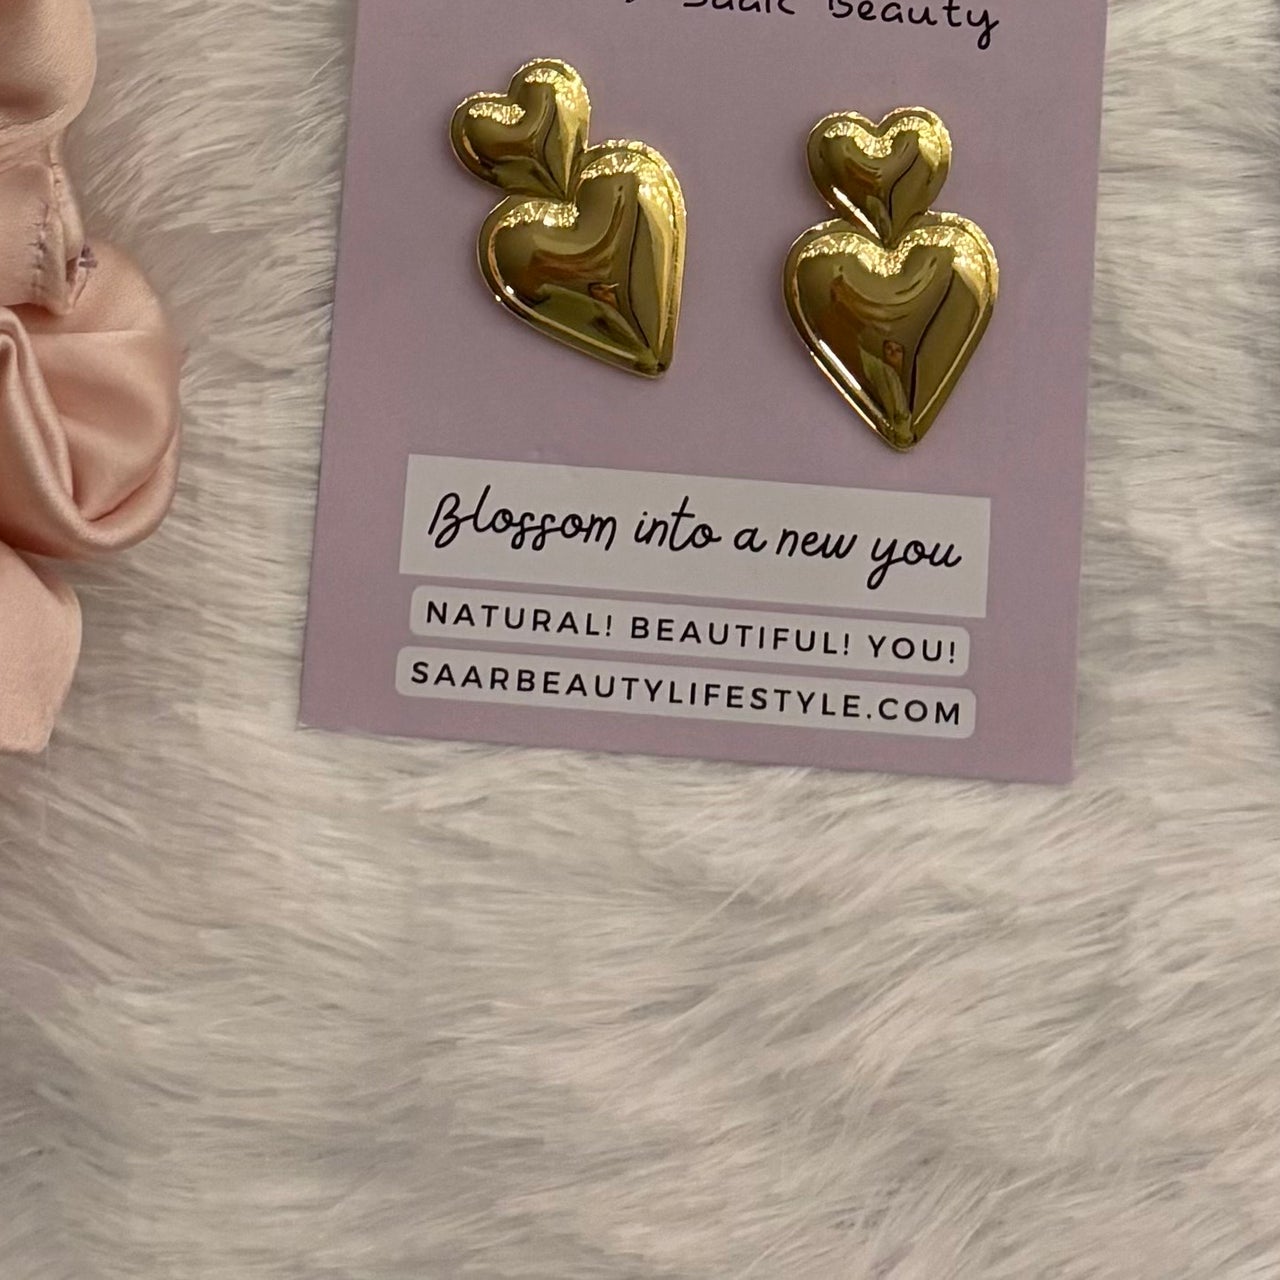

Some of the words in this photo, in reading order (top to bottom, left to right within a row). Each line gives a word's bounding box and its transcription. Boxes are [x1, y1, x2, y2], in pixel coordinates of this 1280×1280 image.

[428, 485, 617, 552] Blossom
[634, 496, 721, 552] into
[734, 526, 768, 553] a
[776, 523, 858, 560] new
[868, 535, 962, 591] you
[426, 601, 614, 637] NATURAL!
[631, 616, 851, 656] BEAUTIFUL!
[868, 635, 956, 664] YOU!
[410, 661, 962, 726] SAARBEAUTYLIFESTYLE.COM
